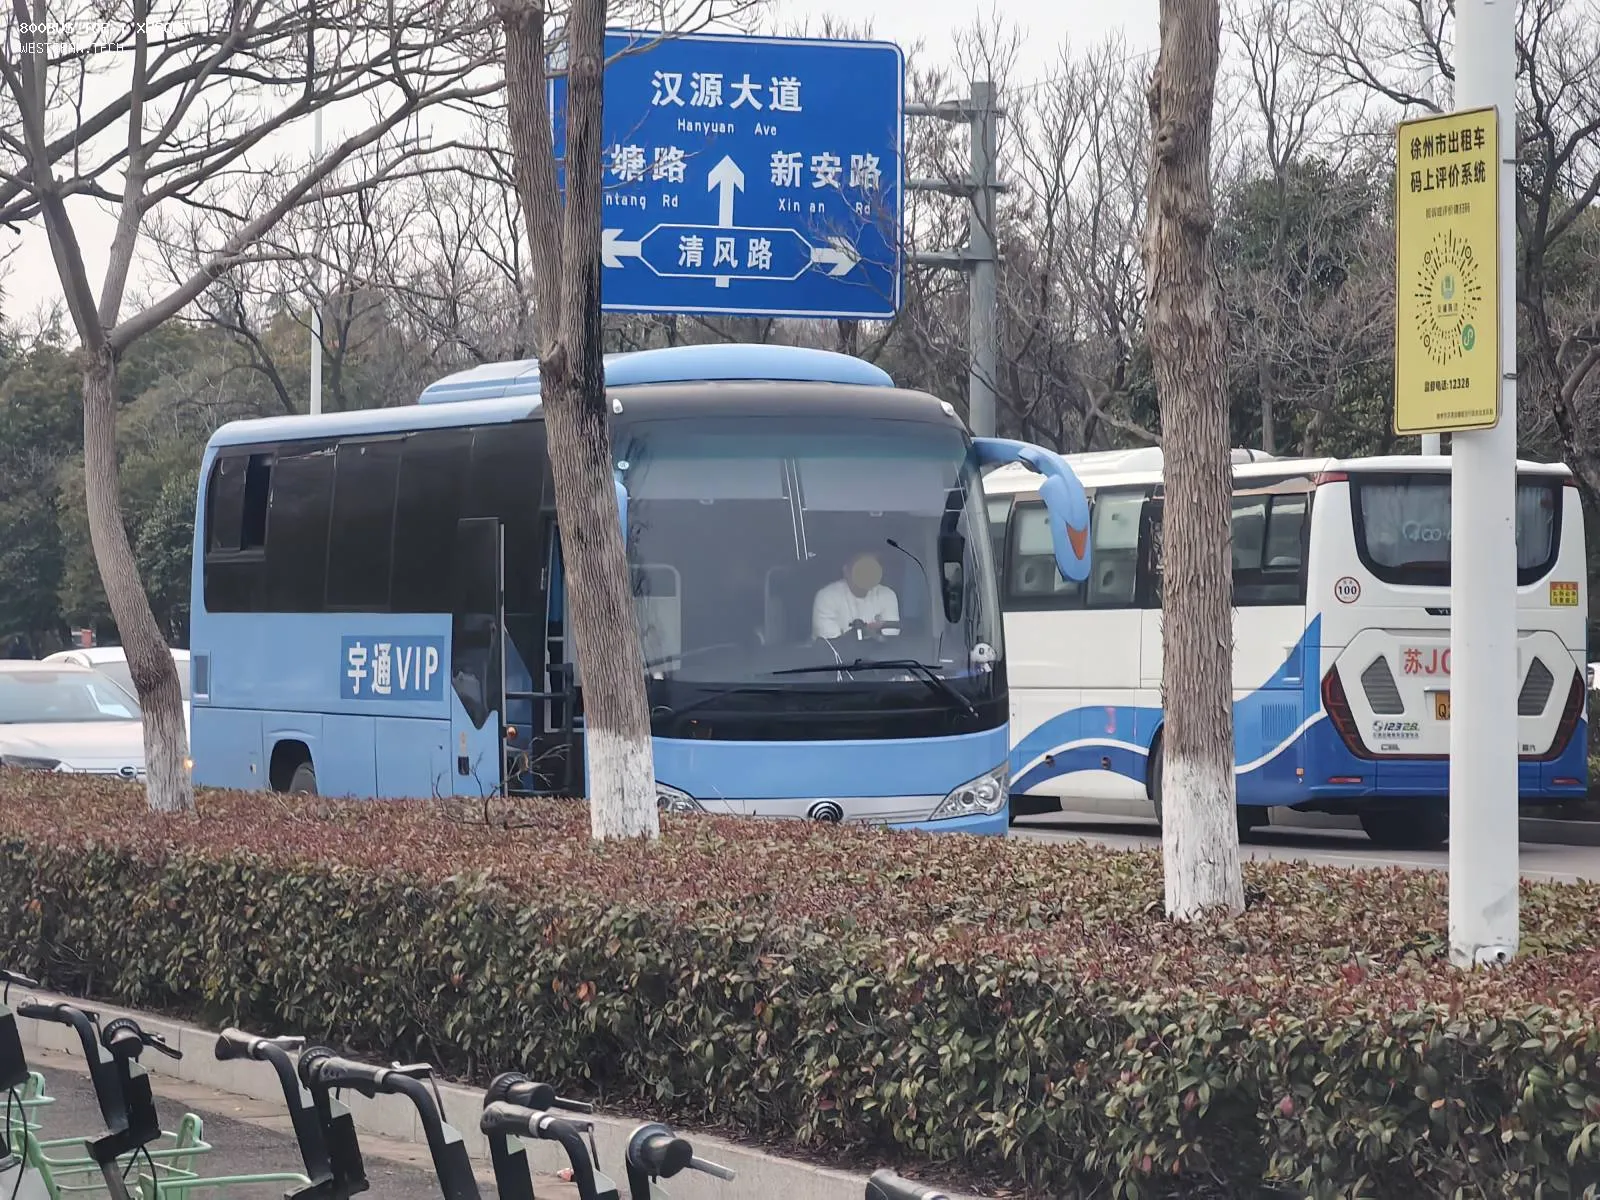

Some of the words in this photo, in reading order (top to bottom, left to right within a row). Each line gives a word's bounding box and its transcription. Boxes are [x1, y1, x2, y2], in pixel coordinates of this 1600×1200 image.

[651, 70, 803, 112] 汉源大道
[677, 118, 735, 136] Hanyuan
[754, 122, 778, 136] Ave
[1410, 125, 1486, 161] 徐州市出租车
[602, 144, 687, 184] 塘路
[769, 150, 882, 190] 新安路
[1410, 160, 1487, 193] 码上评价系统
[605, 192, 647, 210] ntang
[662, 194, 679, 208] Rd
[778, 198, 801, 213] Xin
[855, 201, 871, 216] Rd
[678, 234, 773, 270] 清风路
[1338, 585, 1357, 596] 100
